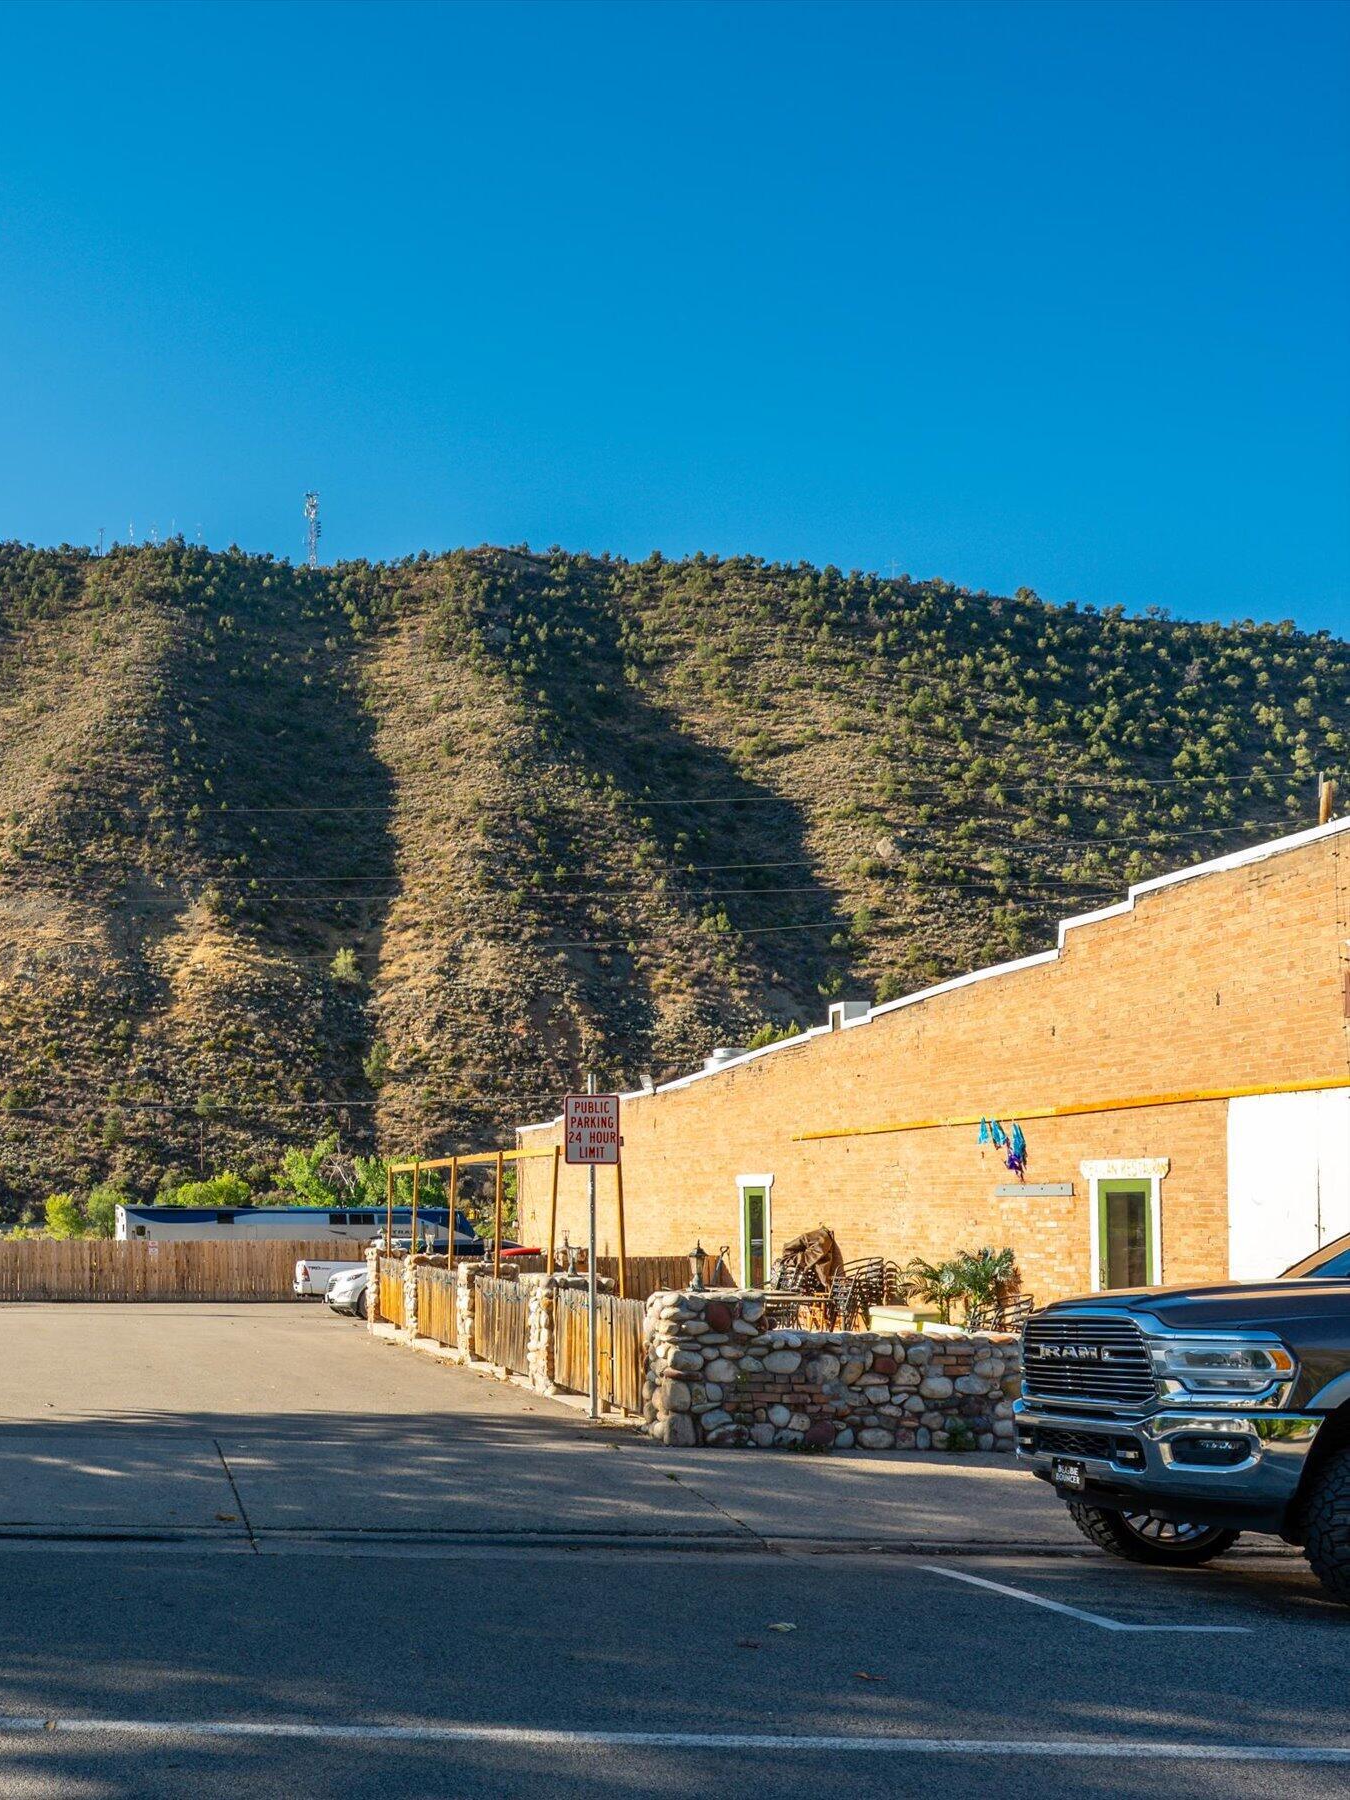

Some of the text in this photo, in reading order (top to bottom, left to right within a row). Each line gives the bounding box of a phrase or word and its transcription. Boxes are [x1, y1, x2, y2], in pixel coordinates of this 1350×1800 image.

[574, 1101, 610, 1113] PUBLIC
[570, 1116, 614, 1128] PARKING
[568, 1131, 616, 1143] 24 HOUR
[579, 1146, 605, 1158] LIMIT
[1043, 1345, 1097, 1359] RAM
